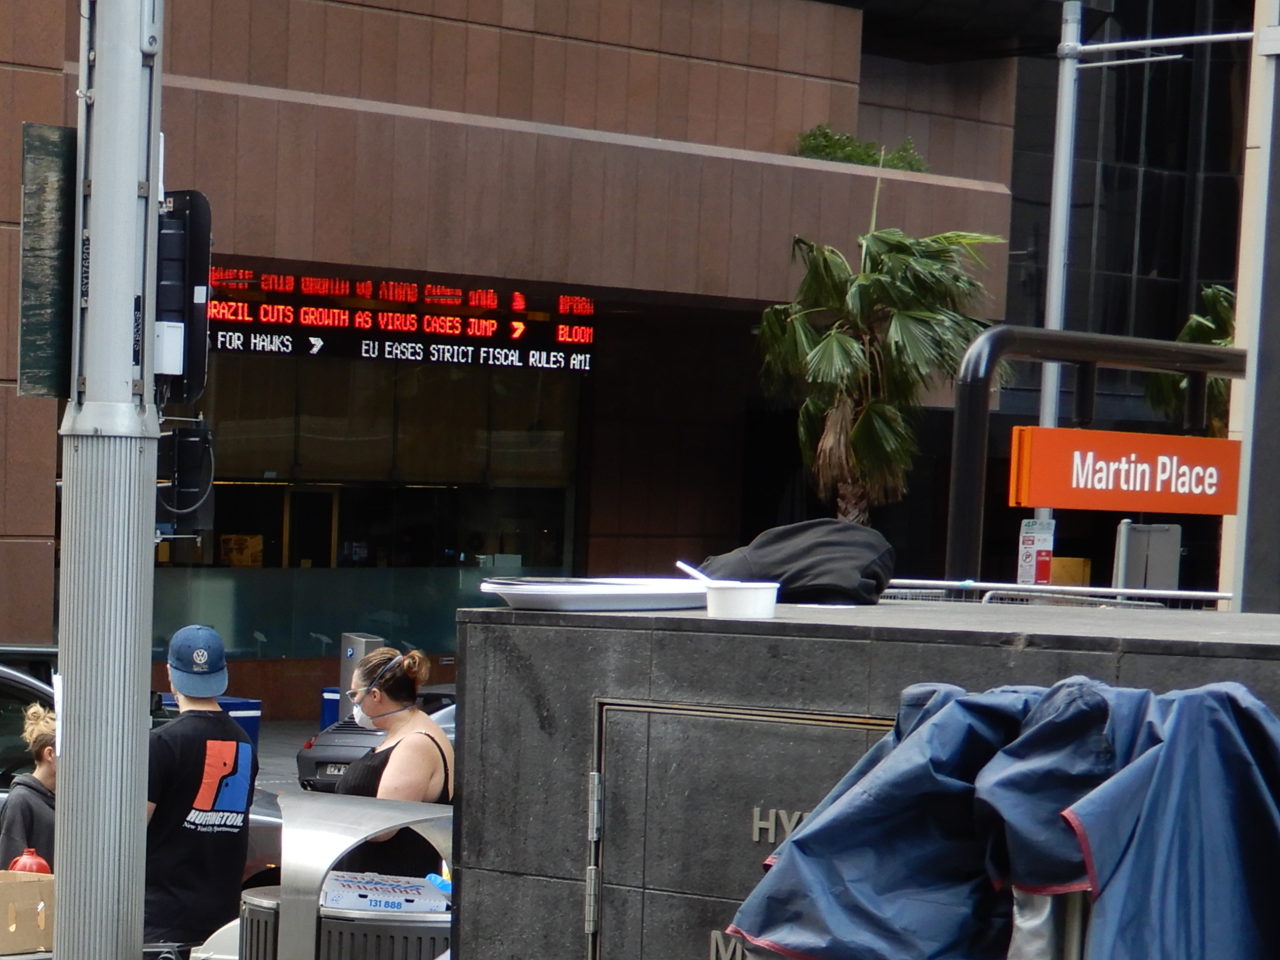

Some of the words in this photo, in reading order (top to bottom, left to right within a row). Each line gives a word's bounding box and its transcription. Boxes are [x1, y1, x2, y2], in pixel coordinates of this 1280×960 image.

[260, 303, 294, 324] CUTS
[300, 307, 349, 327] GROWTH
[355, 311, 372, 329] AS
[378, 313, 417, 332] VIRUS
[424, 315, 462, 335] CASES
[468, 318, 497, 337] JUMP
[557, 325, 593, 343] BLOOM
[217, 331, 244, 350] FOR
[250, 333, 292, 353] HAWKS
[361, 340, 378, 358] EU
[384, 341, 424, 360] EASES
[429, 344, 474, 364] STRICT
[480, 347, 523, 366] FISCAL
[529, 350, 565, 368] RULES
[1072, 450, 1150, 492] Martin
[1155, 455, 1218, 496] Place
[368, 898, 382, 908] 131
[383, 900, 402, 910] 888
